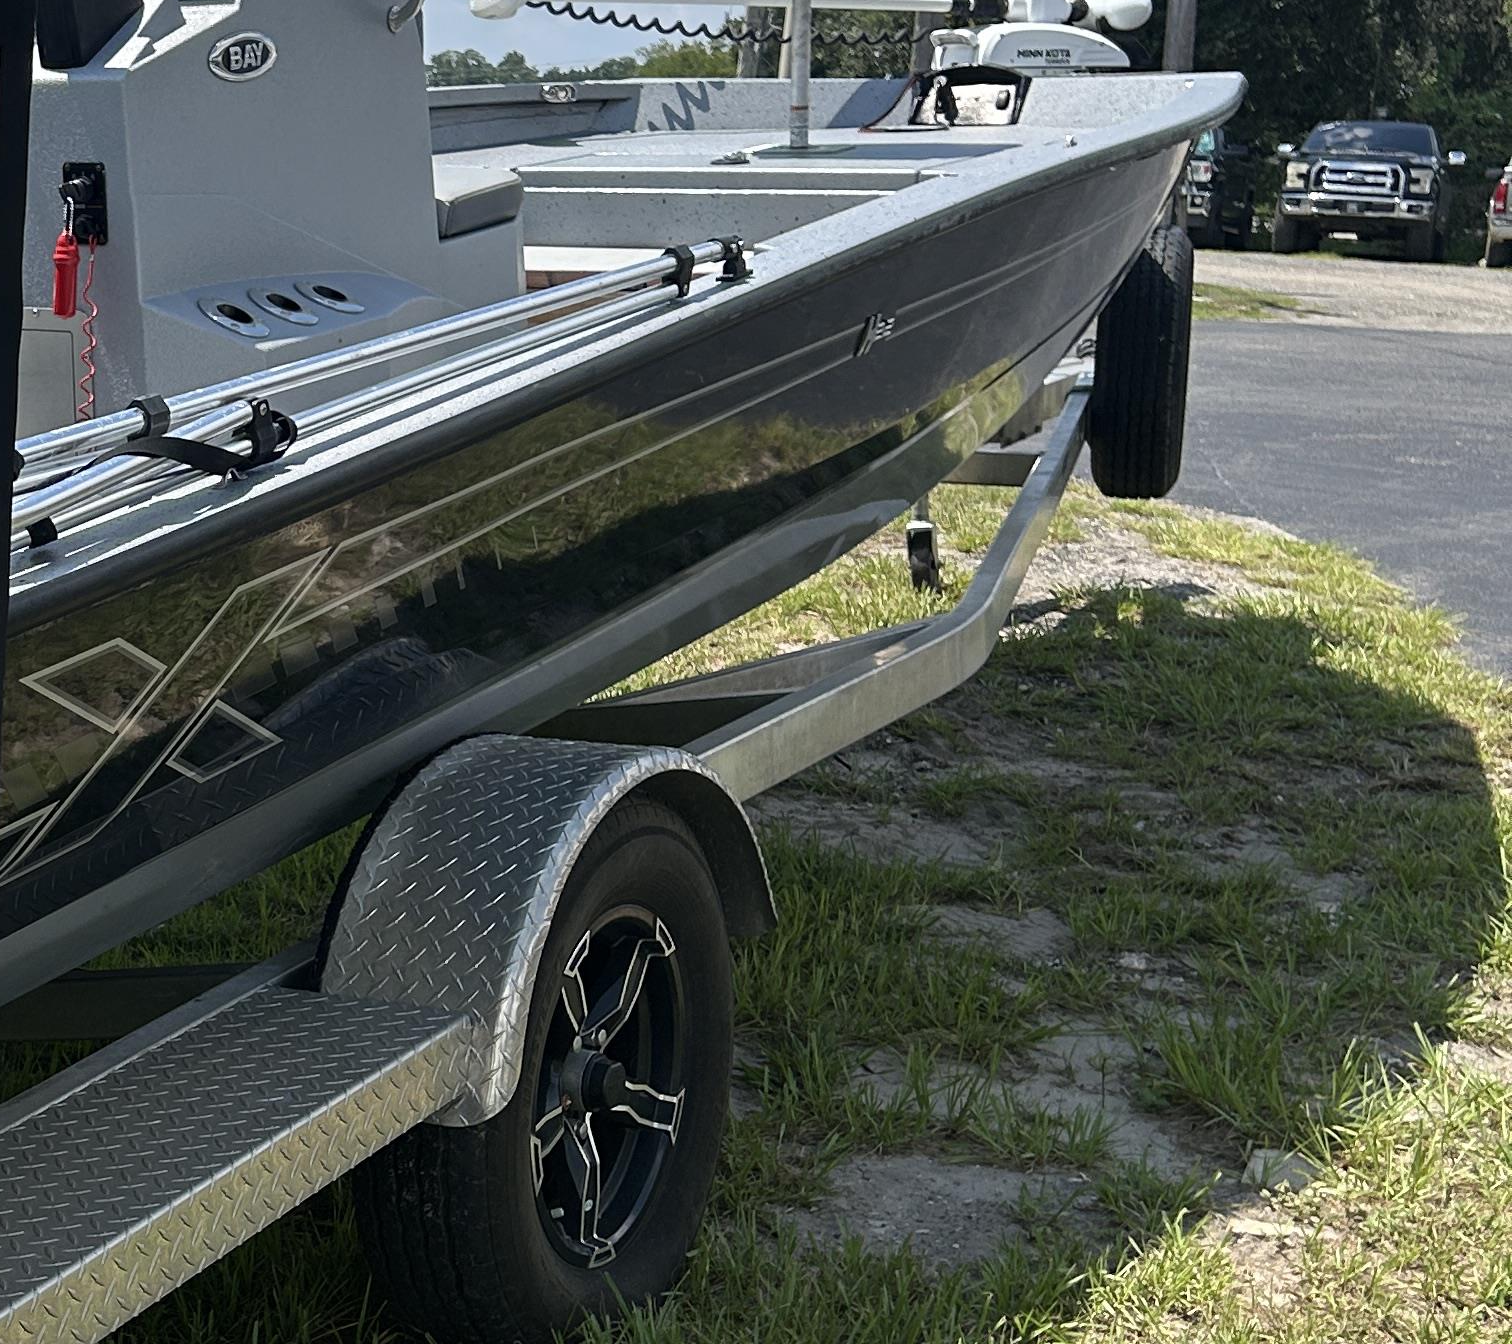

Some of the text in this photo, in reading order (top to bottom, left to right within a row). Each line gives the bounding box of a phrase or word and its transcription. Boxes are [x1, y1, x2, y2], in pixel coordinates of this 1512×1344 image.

[229, 42, 264, 71] BAY
[1016, 48, 1071, 58] MINN KOTA
